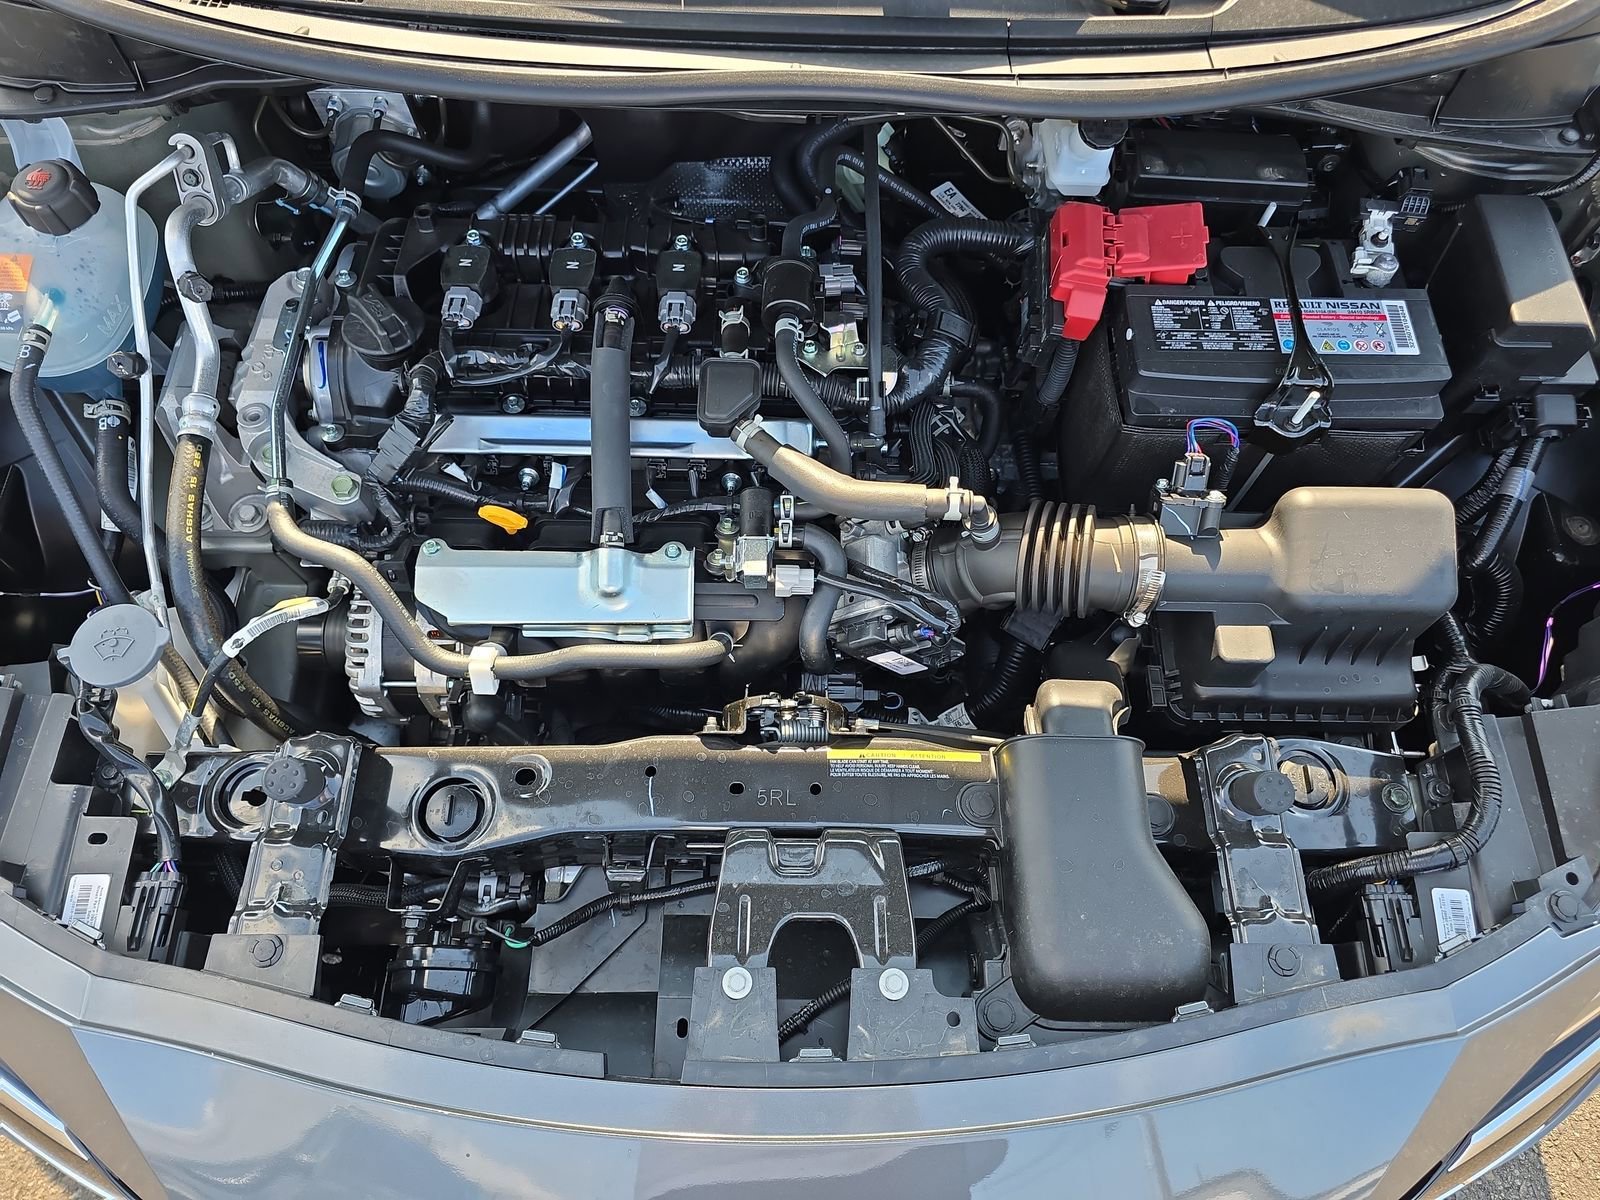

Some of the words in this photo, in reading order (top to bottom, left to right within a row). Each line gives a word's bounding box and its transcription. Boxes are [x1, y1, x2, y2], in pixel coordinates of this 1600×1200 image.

[944, 187, 957, 199] EA
[20, 344, 30, 358] B
[99, 417, 107, 430] B
[190, 476, 198, 488] 15
[186, 550, 197, 588] YOKOHAMA
[251, 698, 261, 708] 15
[757, 790, 796, 806] 5RL
